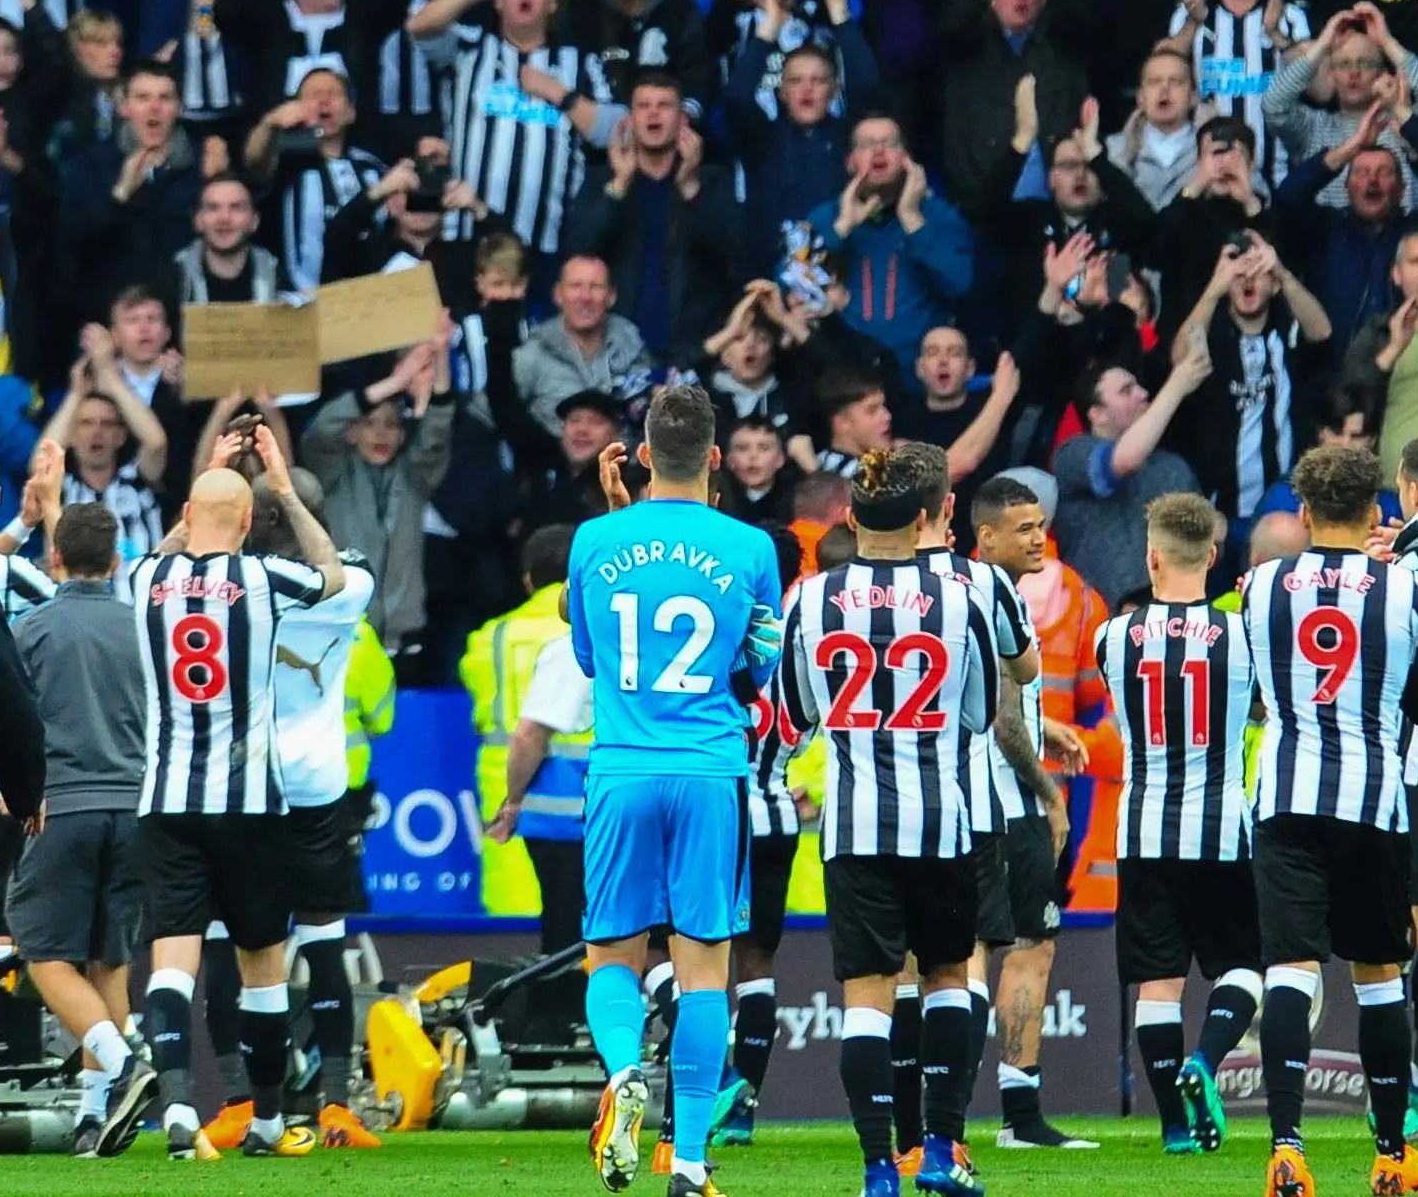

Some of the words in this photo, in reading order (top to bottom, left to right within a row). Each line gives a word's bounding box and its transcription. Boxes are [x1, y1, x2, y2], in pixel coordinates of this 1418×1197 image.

[150, 575, 247, 607] SHELVEY
[597, 540, 736, 596] DÚBRAVKA
[828, 584, 935, 618] YEDLIN
[1282, 568, 1377, 595] GAYLE
[171, 612, 228, 704] 8
[608, 592, 716, 695] 12
[1128, 617, 1224, 648] RITCHIE
[1296, 605, 1360, 704] 9
[814, 629, 951, 732] 22
[1136, 659, 1210, 747] 11
